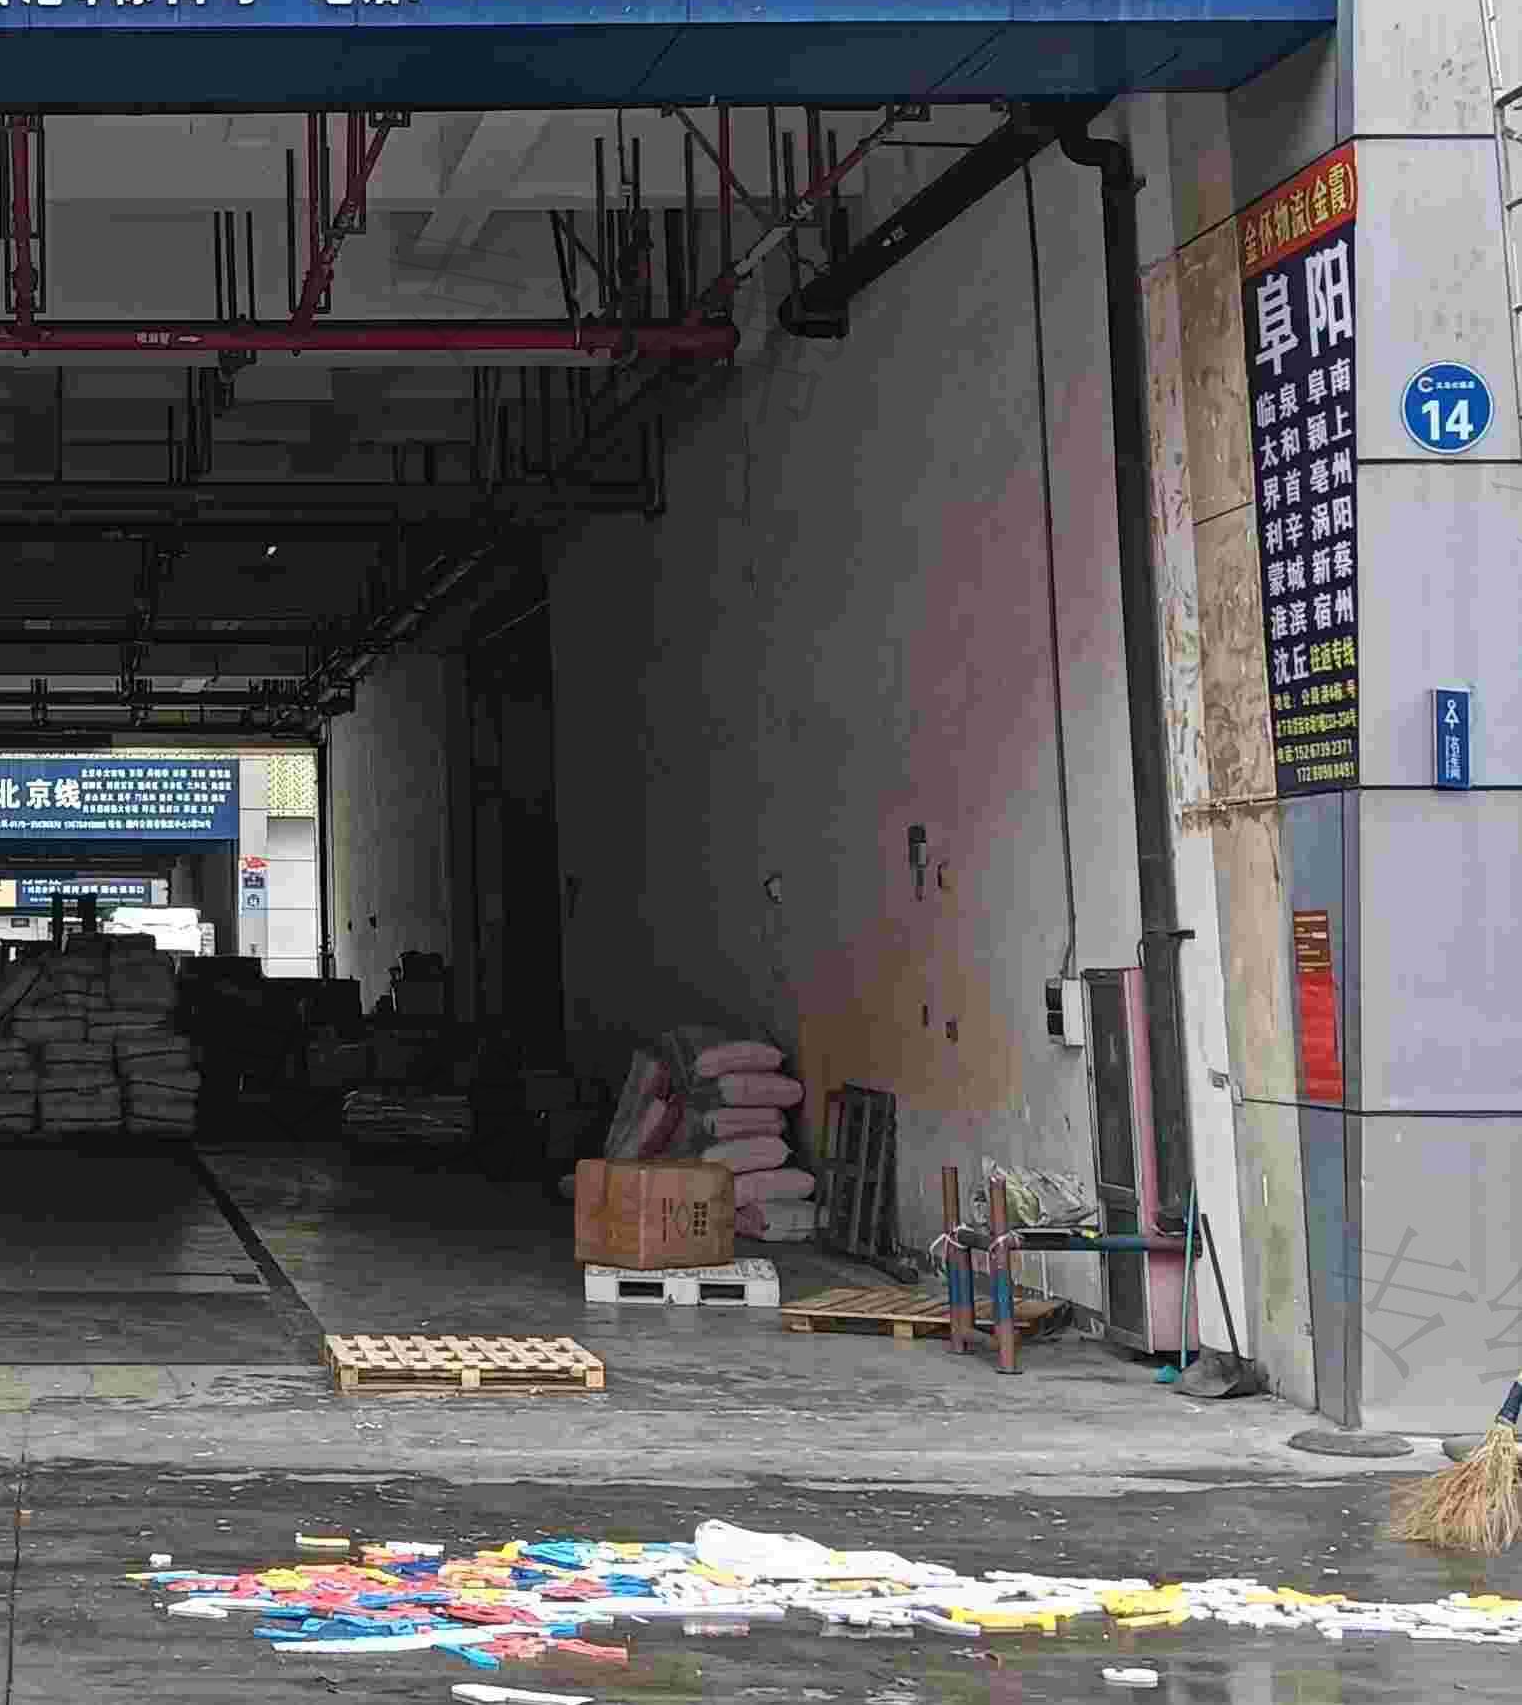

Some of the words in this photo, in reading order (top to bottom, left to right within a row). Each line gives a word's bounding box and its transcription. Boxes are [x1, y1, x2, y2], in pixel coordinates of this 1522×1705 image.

[1255, 238, 1354, 376] 阜阳
[1256, 382, 1300, 429] 临泉
[1306, 357, 1352, 405] 阜南
[1421, 399, 1474, 441] 14
[1259, 425, 1301, 471] 太和
[1262, 468, 1302, 514] 界首
[1264, 512, 1304, 555] 利辛
[1310, 495, 1353, 542] 涡阳
[1267, 554, 1307, 597] 蒙城
[1312, 540, 1354, 586] 新蔡
[1270, 599, 1309, 641] 淮滨
[1312, 586, 1355, 630] 宿州
